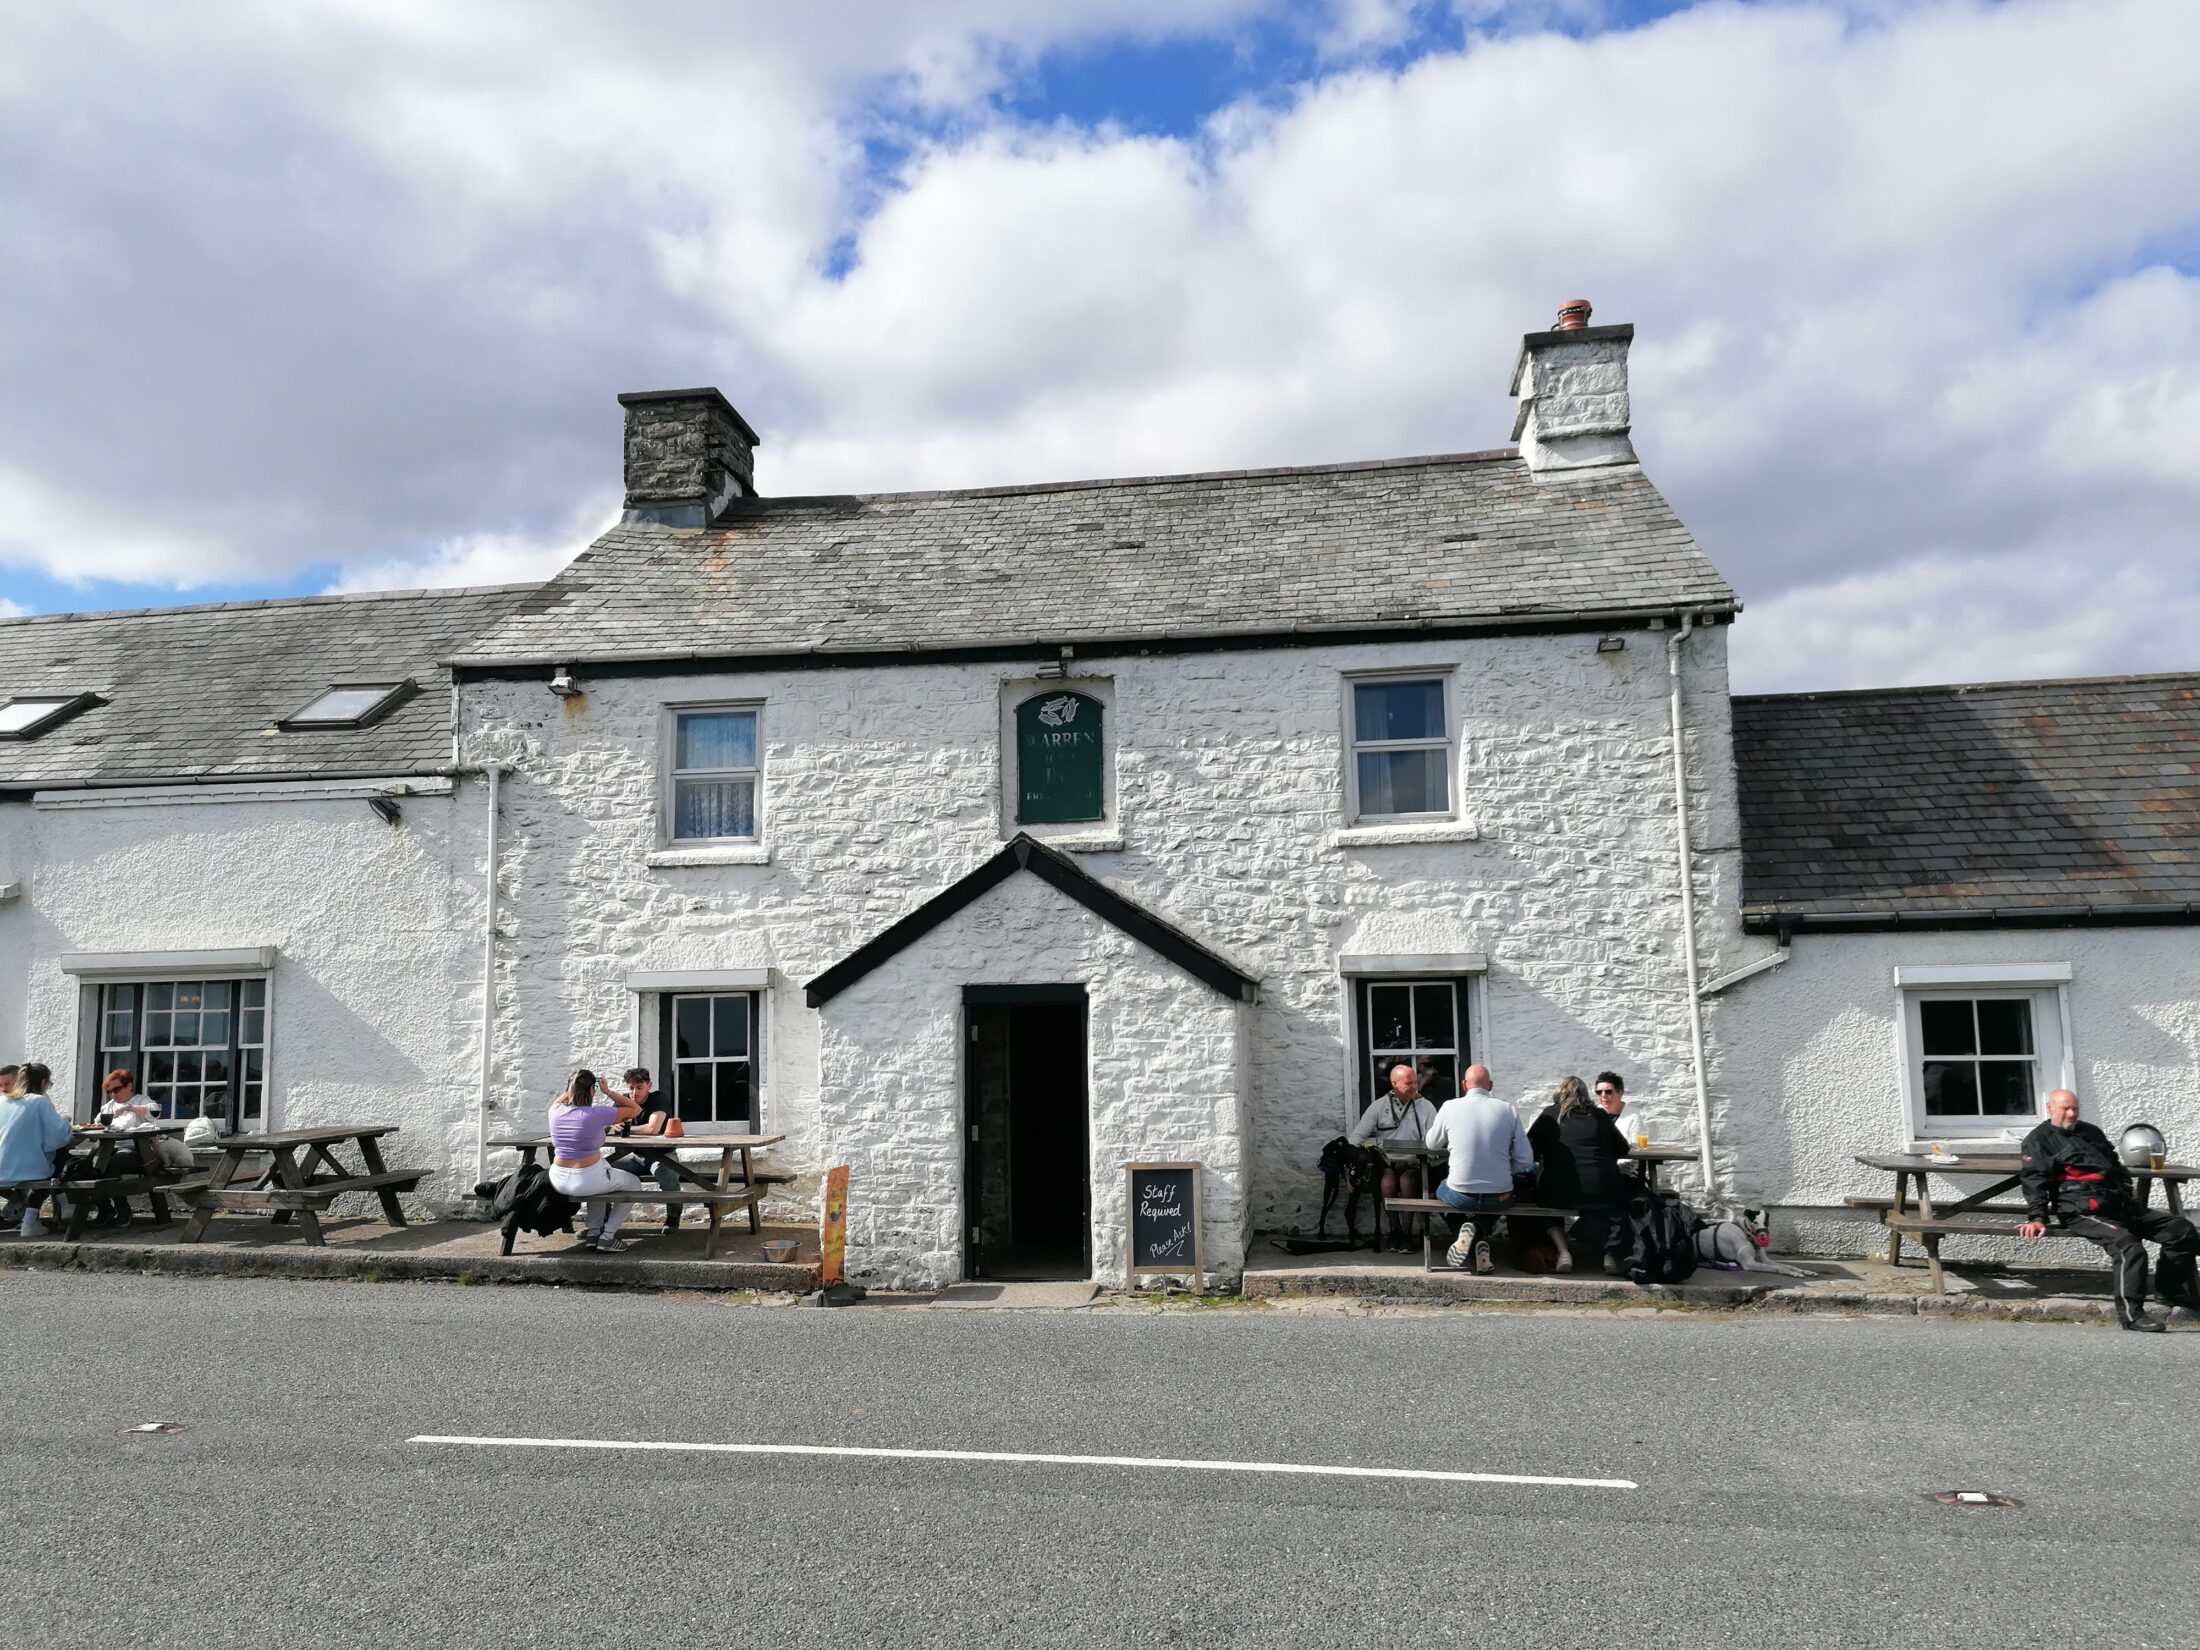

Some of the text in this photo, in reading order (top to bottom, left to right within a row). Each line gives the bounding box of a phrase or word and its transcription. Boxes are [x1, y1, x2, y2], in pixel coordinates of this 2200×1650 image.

[1143, 1184, 1177, 1203] Staff
[1140, 1201, 1182, 1222] Required
[1149, 1221, 1192, 1258] Please Ask!
